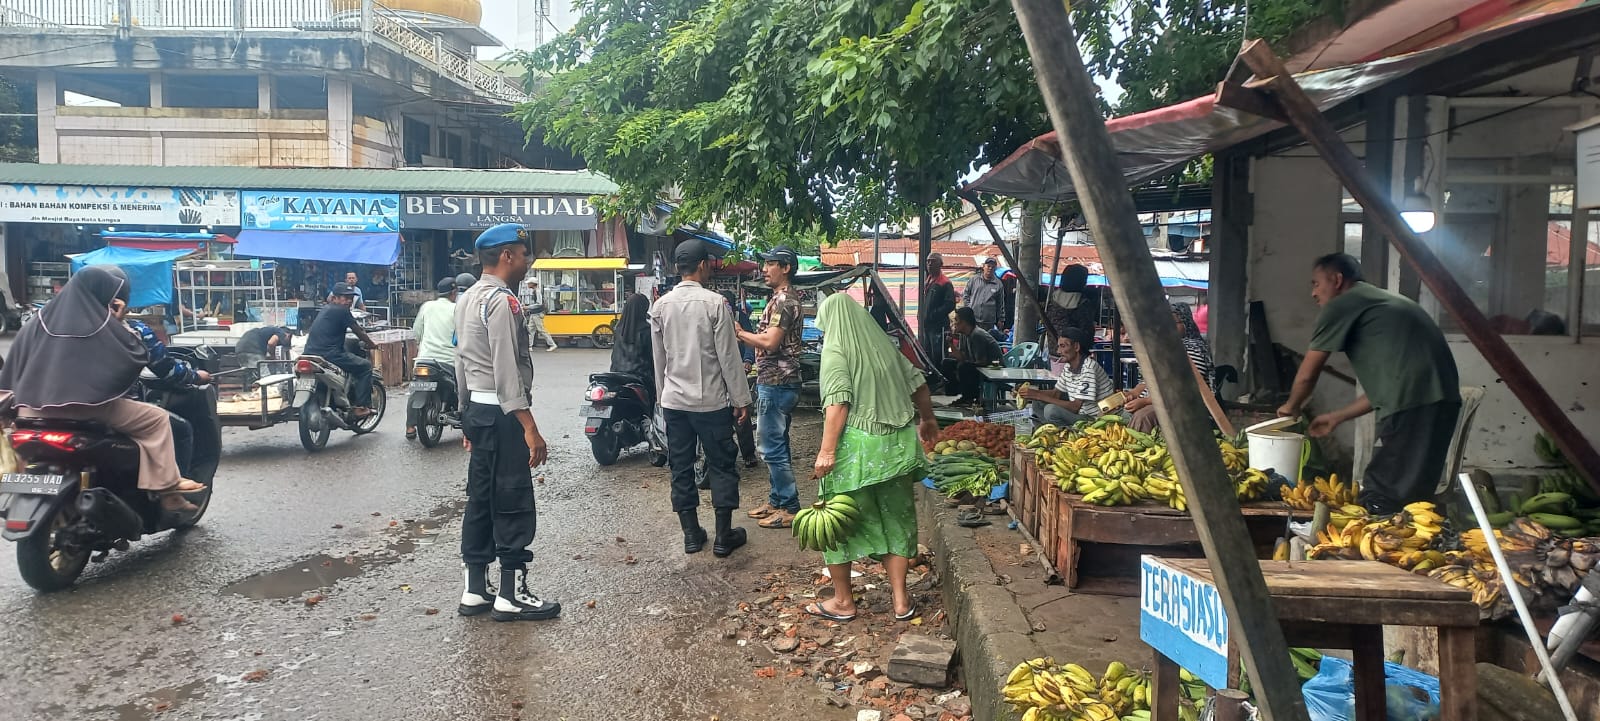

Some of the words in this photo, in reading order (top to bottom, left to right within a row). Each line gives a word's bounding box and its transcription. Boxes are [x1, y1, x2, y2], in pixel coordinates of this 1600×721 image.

[9, 201, 37, 209] BAHAN
[69, 202, 110, 210] KOMPEKSI
[112, 203, 118, 211] &
[120, 203, 162, 211] MENERIMA
[258, 194, 280, 206] Toko
[282, 197, 384, 216] KAYANA
[405, 196, 505, 215] BESTIE
[511, 197, 595, 216] HIJAB
[477, 215, 524, 223] LANGSA
[1079, 382, 1090, 395] 2
[1, 473, 13, 483] BL
[14, 473, 40, 484] 3255
